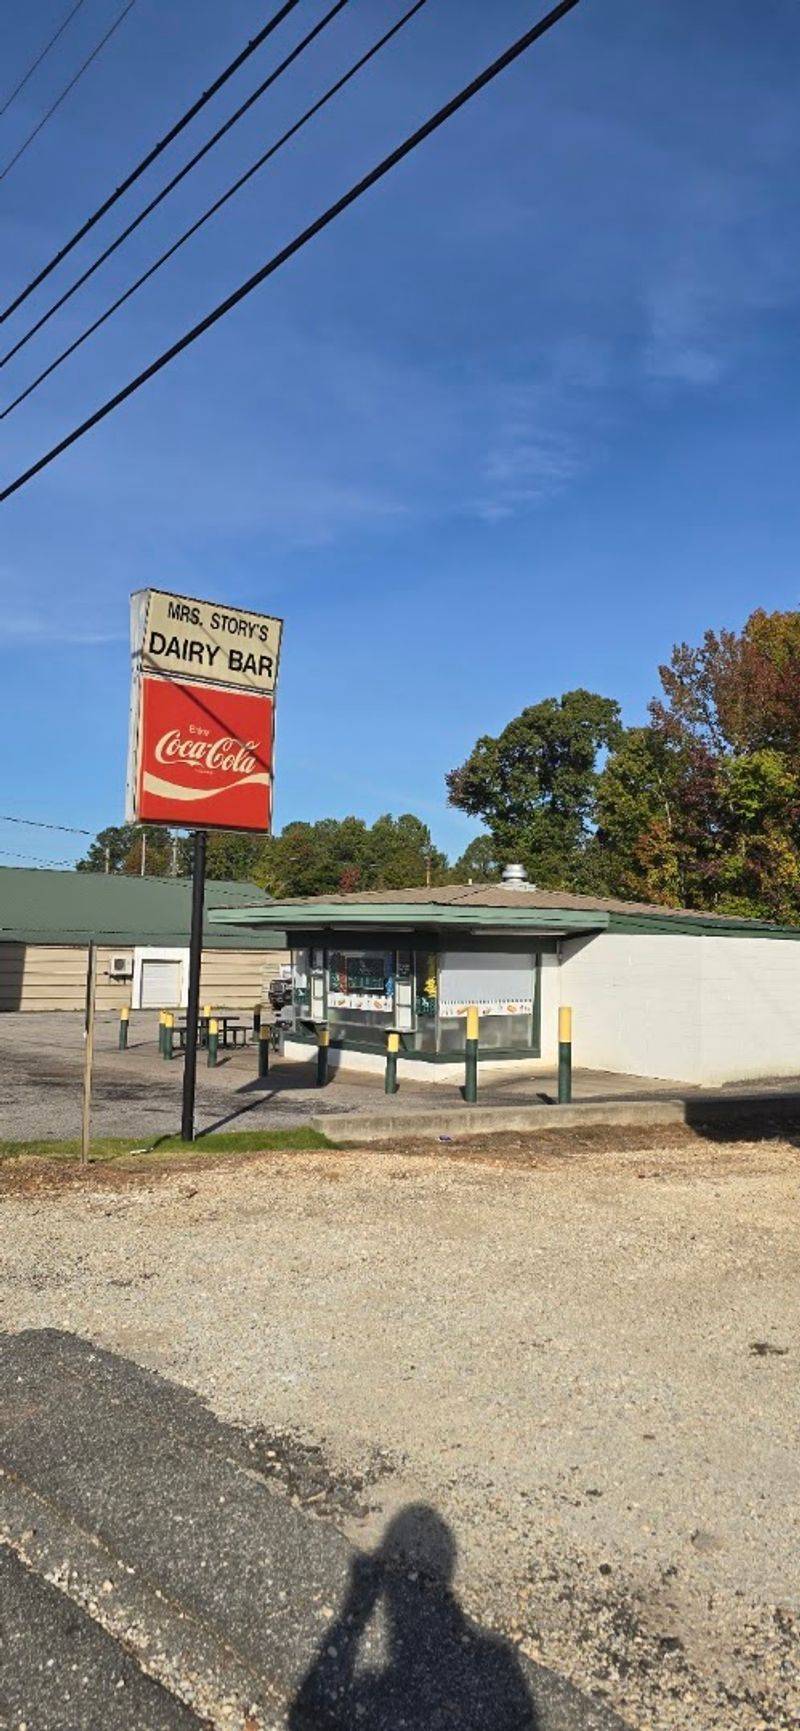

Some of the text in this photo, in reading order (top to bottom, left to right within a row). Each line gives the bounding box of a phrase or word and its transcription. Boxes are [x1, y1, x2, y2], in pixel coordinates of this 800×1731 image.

[167, 601, 269, 642] MRS. STORY'S
[149, 631, 273, 678] DAIRY BAR
[155, 728, 261, 774] Coca-Cola
